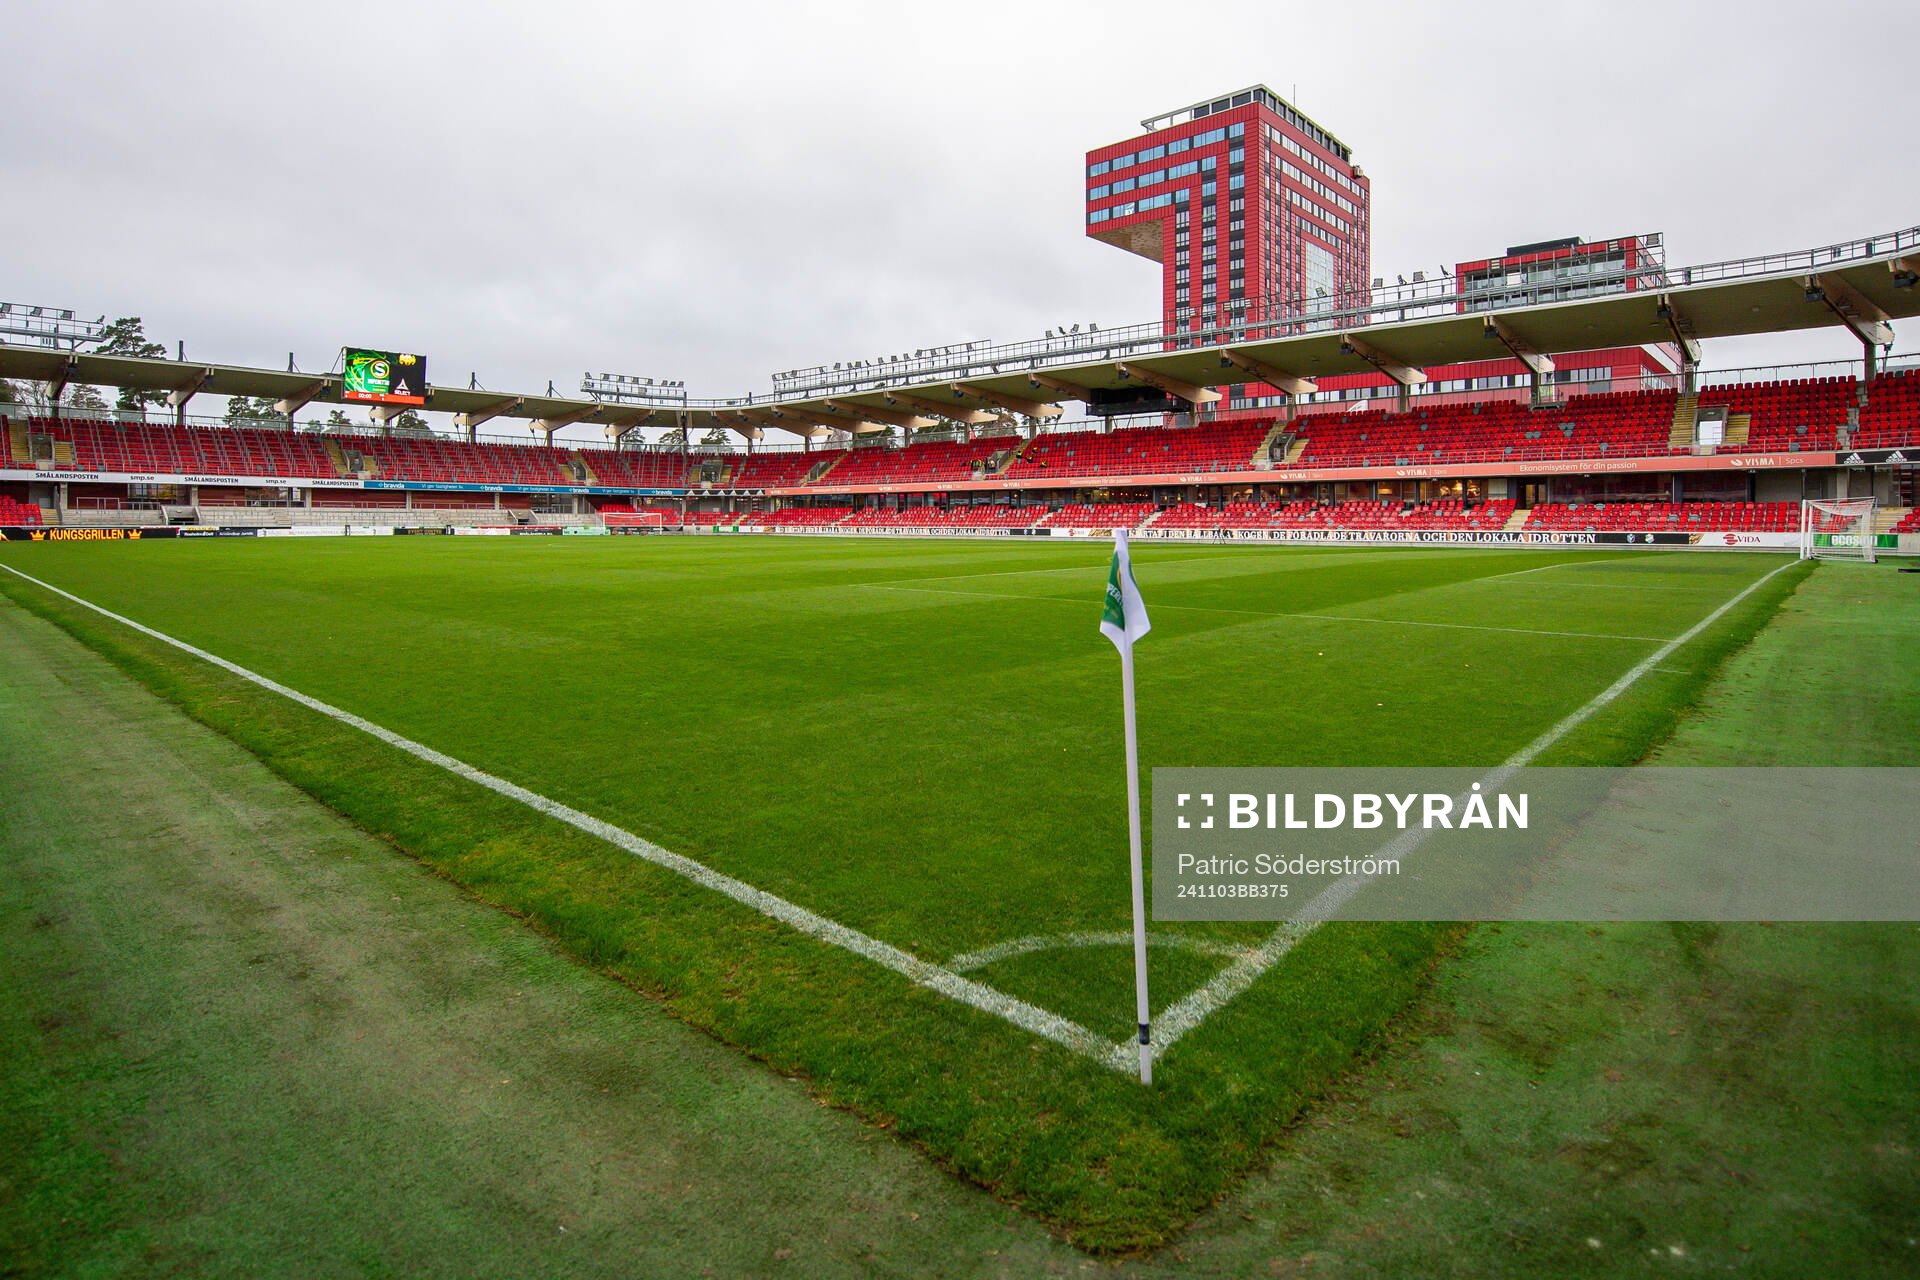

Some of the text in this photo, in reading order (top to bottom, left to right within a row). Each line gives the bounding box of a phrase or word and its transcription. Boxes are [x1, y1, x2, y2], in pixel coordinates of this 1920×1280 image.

[1745, 457, 1804, 466] VISMA Spcs
[1519, 463, 1578, 472] Ekonomisystem
[1592, 462, 1605, 470] din
[1606, 461, 1637, 471] passion
[35, 471, 100, 481] SMÅLANDSPOSTEN
[130, 474, 155, 483] smp.se
[184, 475, 239, 484] SMÅLANDSPOSTEN
[265, 478, 287, 486] smp.se
[312, 479, 359, 487] SMÅLANDSPOSTEN
[50, 529, 124, 540] KUNGSGRILLEN
[1422, 532, 1447, 541] OCH
[1449, 532, 1474, 542] DEN
[1475, 532, 1525, 543] LOKALA
[1528, 533, 1597, 543] IDROTTEN
